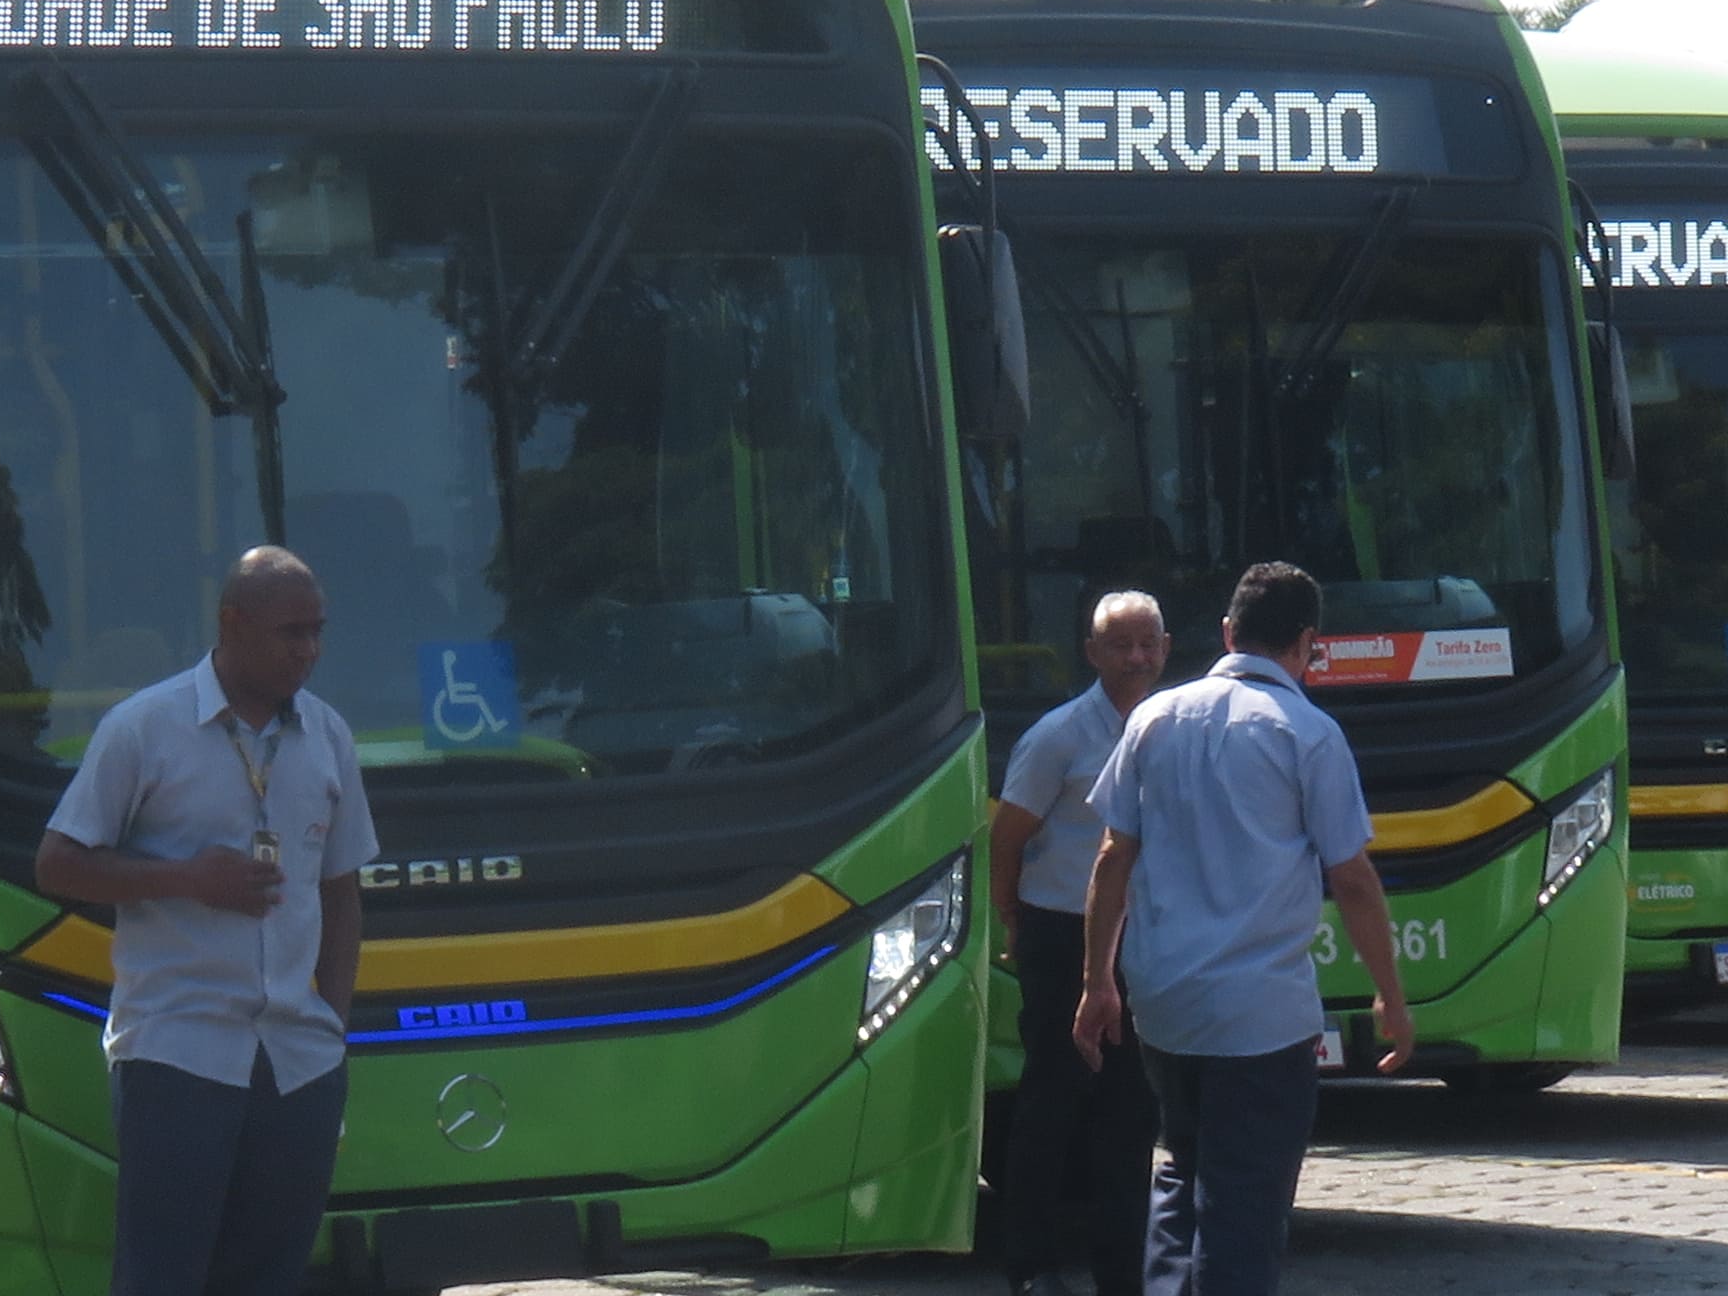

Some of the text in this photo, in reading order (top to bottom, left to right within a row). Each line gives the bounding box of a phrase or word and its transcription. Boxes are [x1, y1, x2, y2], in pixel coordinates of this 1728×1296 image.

[359, 856, 521, 888] CAIO
[1637, 883, 1695, 901] ELÉTRICO
[398, 1000, 527, 1029] CAIO
